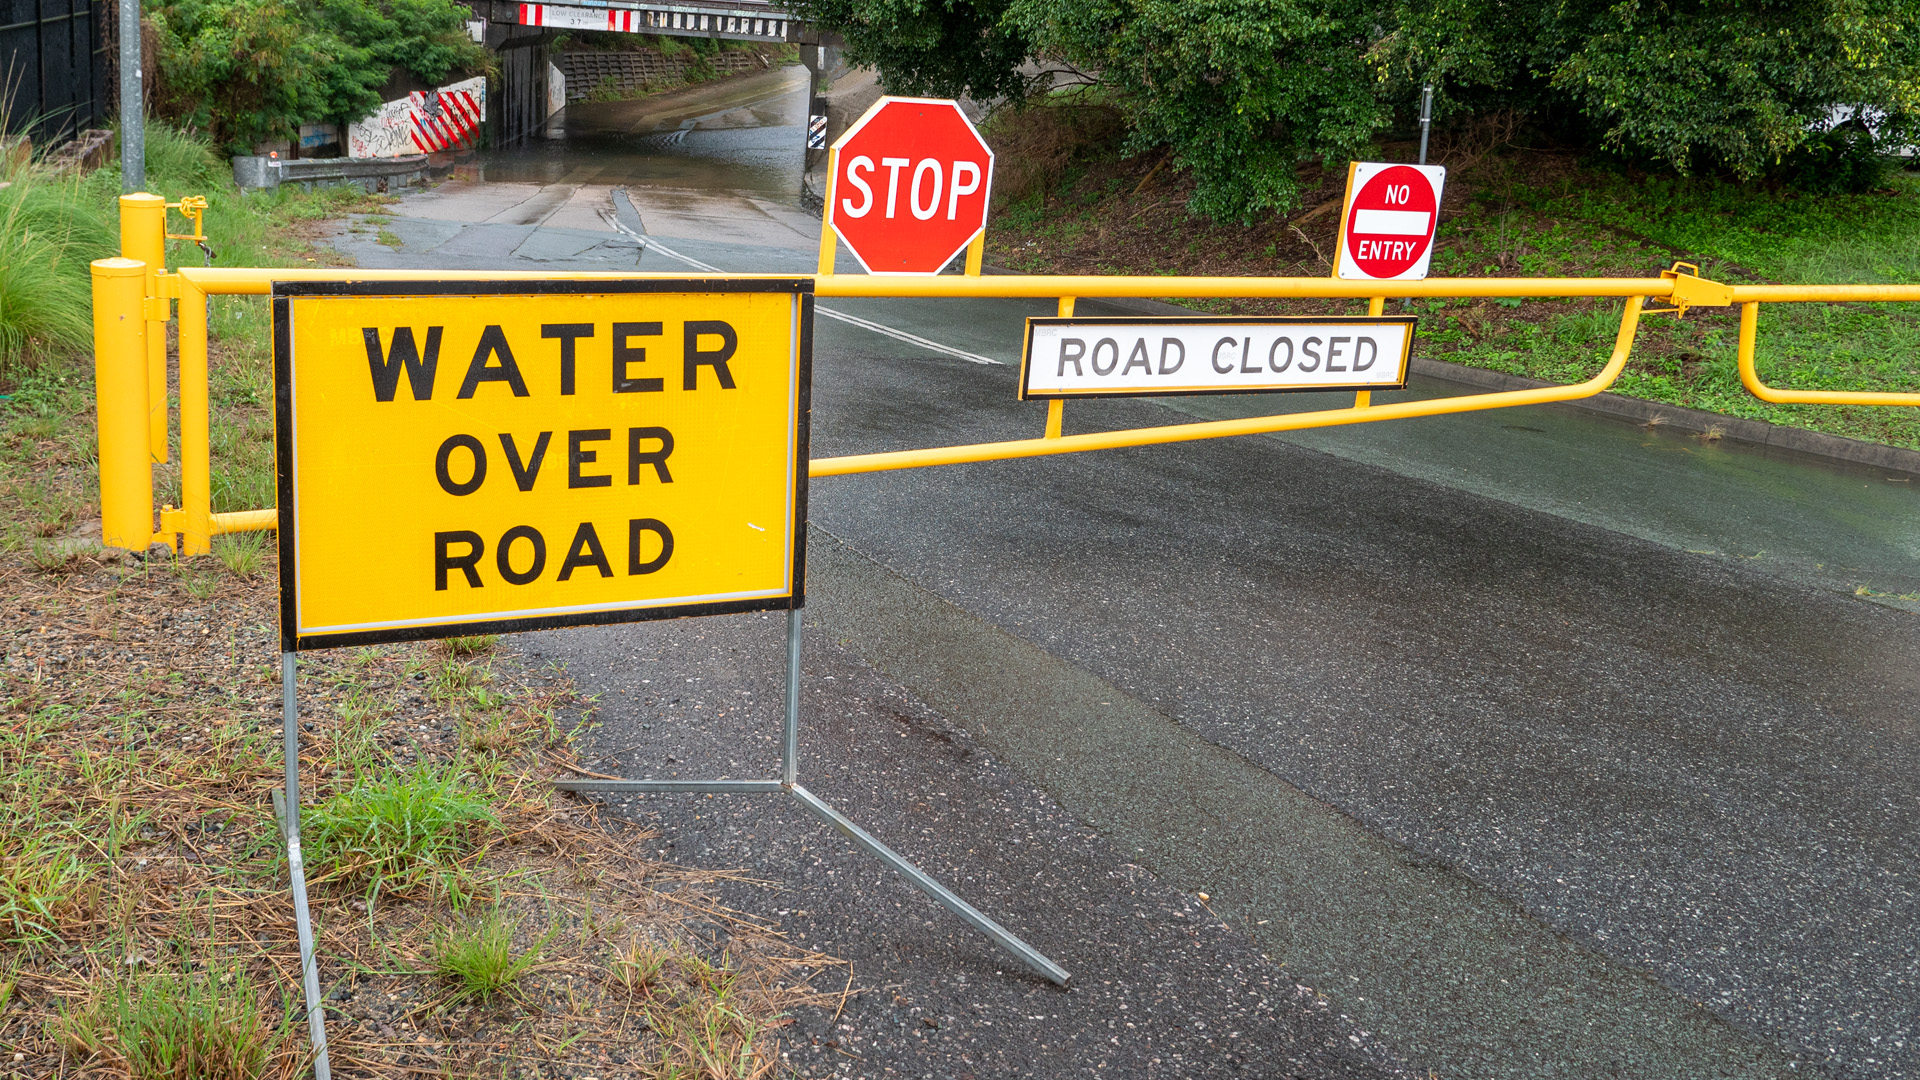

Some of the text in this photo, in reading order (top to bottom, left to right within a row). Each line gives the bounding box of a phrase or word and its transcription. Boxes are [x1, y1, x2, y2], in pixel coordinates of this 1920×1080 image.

[552, 9, 607, 20] LOW CLEARANCE
[842, 155, 981, 221] STOP
[1384, 184, 1410, 205] NO
[1357, 240, 1417, 261] ENTRY
[1035, 328, 1057, 337] MBRC
[362, 320, 738, 402] WATER
[1057, 336, 1378, 377] ROAD CLOSED
[435, 426, 675, 497] OVER
[434, 518, 674, 591] ROAD
